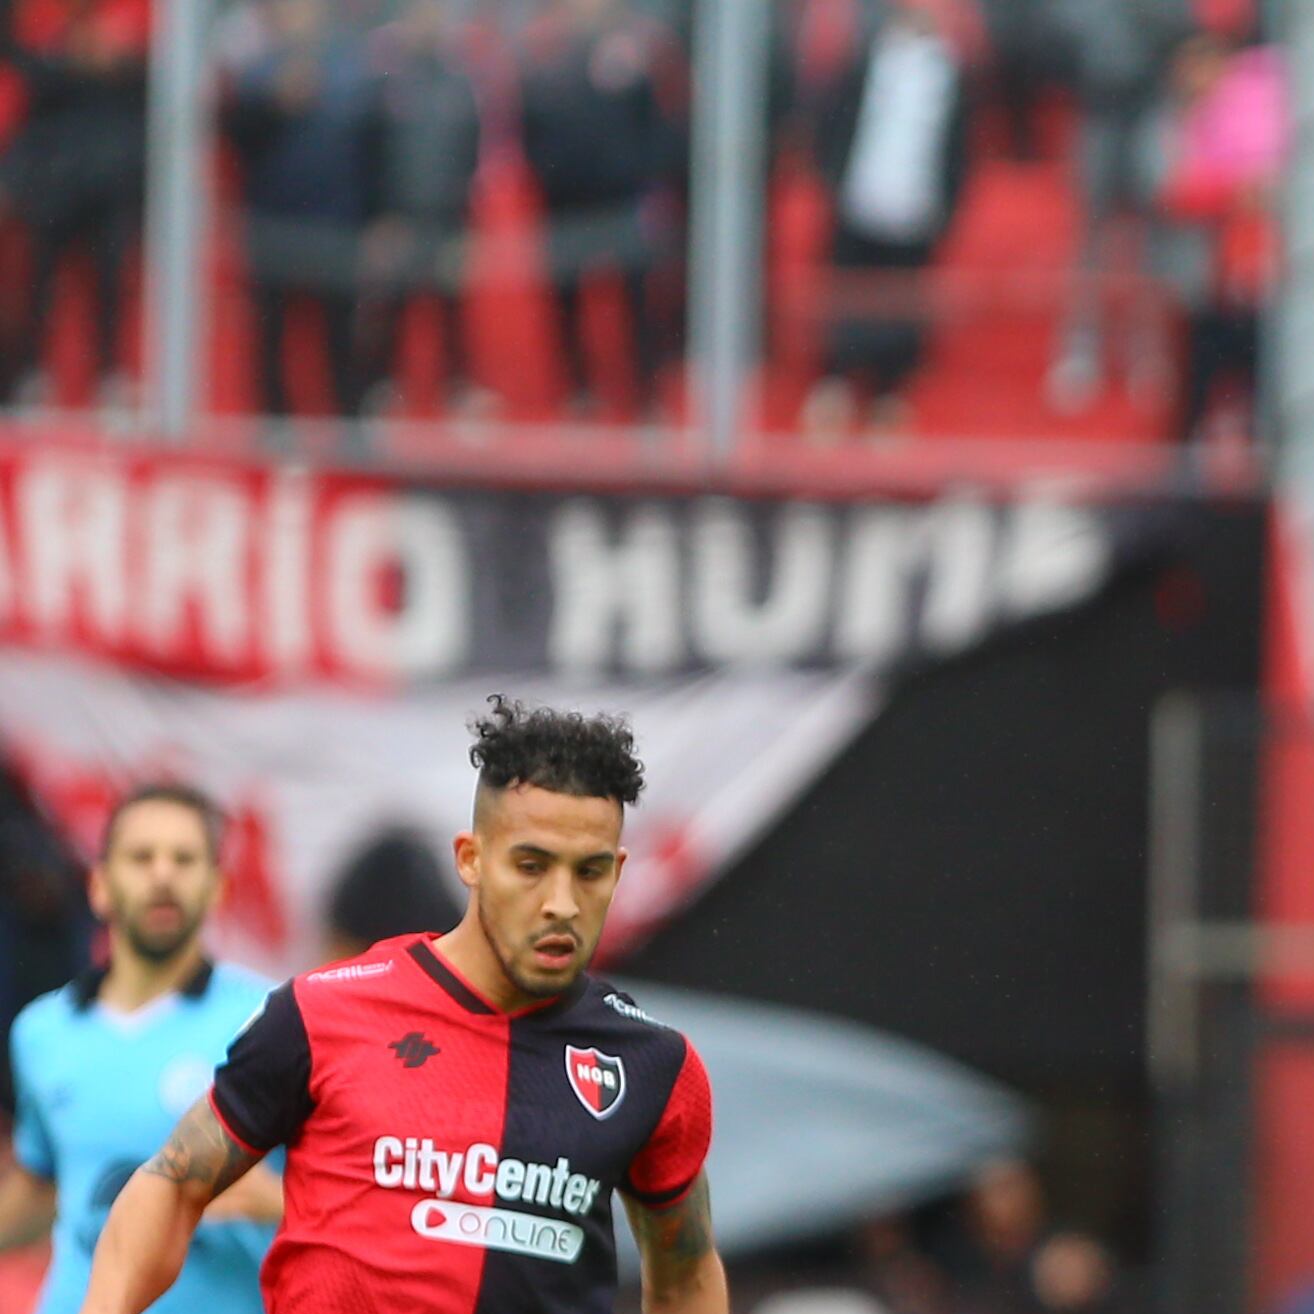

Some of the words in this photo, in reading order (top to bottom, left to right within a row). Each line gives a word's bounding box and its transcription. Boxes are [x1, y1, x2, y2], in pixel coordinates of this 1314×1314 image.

[0, 450, 468, 686] RRIO
[576, 1063, 616, 1090] NOB
[374, 1135, 601, 1215] CityCenter
